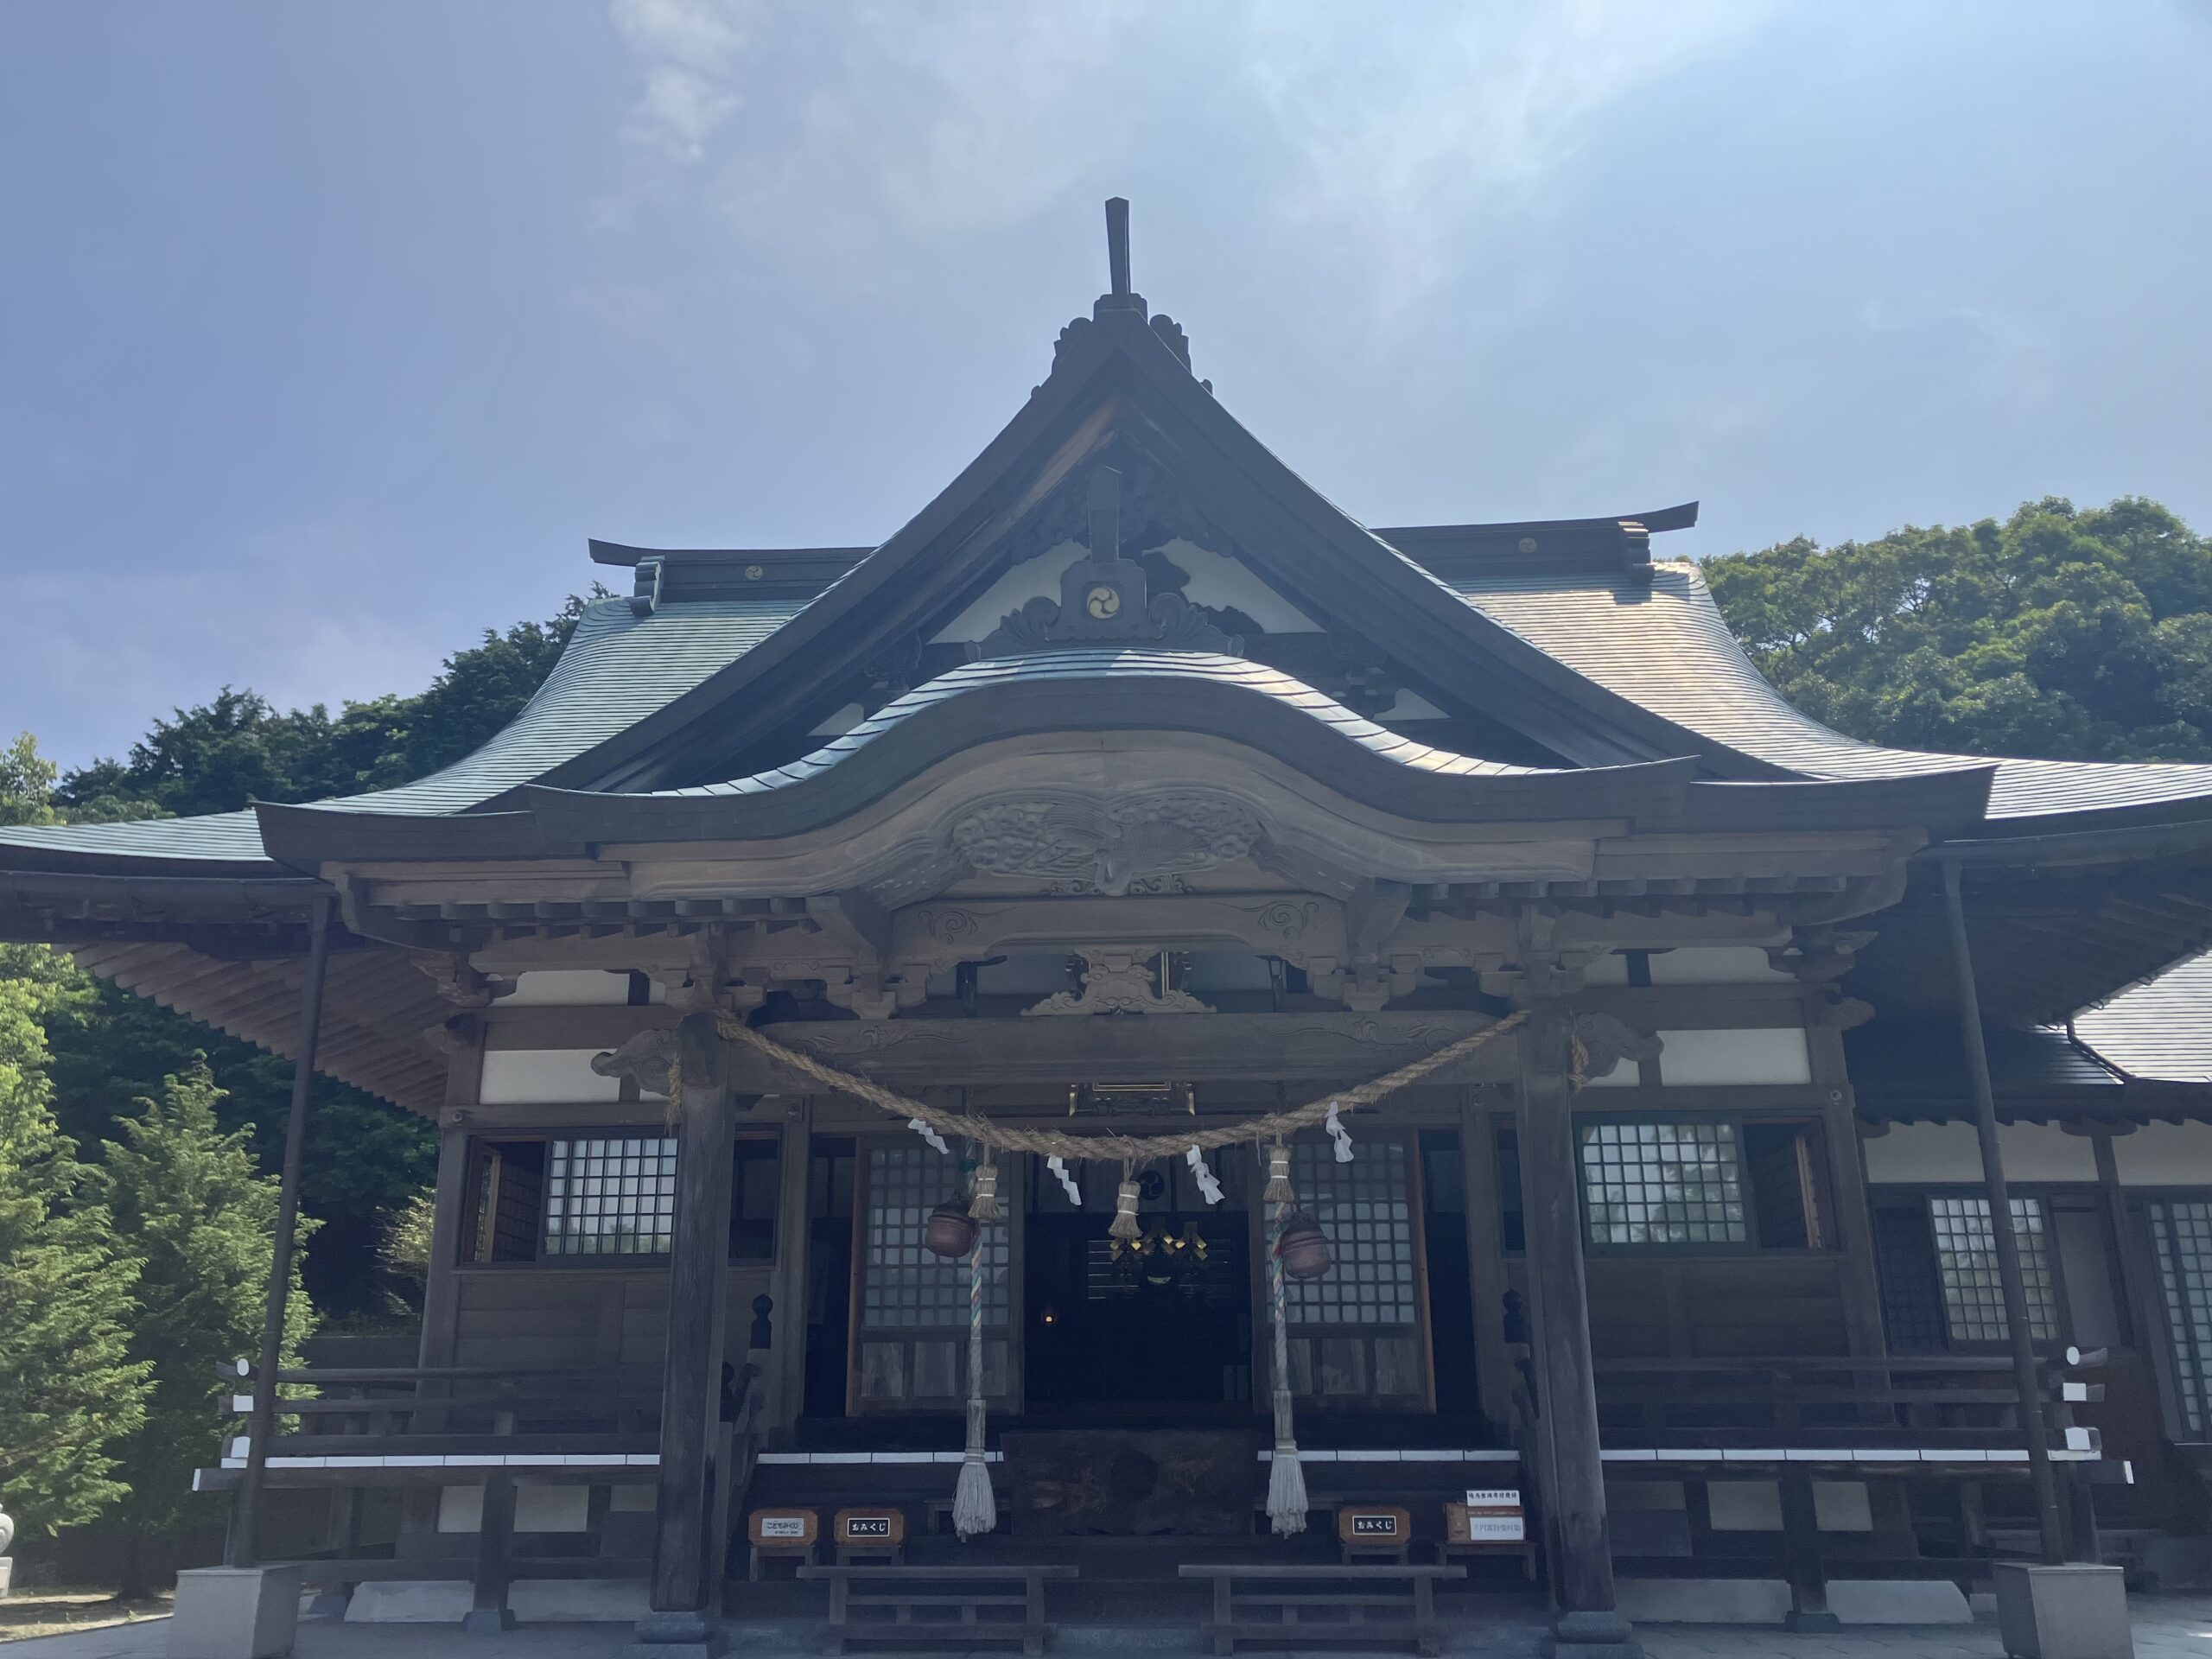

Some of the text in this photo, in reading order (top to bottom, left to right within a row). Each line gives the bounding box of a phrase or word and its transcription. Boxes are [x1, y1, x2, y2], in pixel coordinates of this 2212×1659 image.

[851, 1522, 886, 1531] おみくじ
[1357, 1520, 1392, 1529] おみくじ
